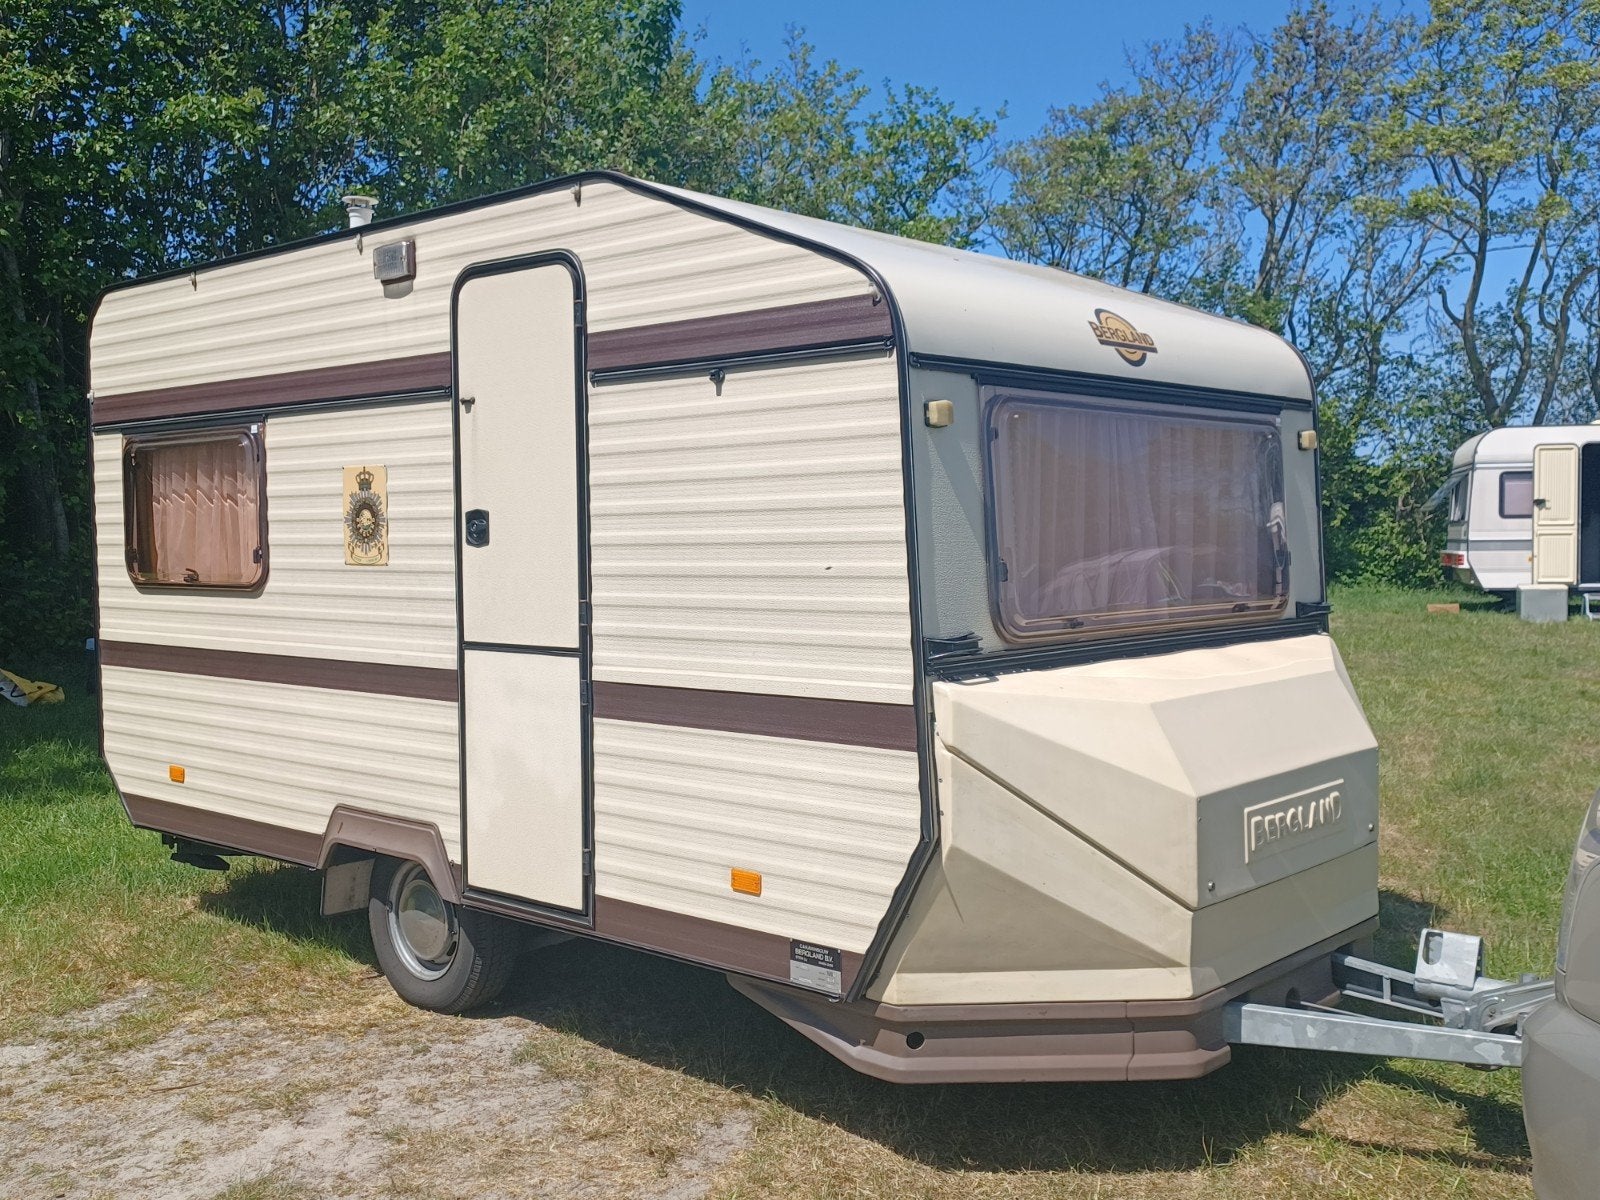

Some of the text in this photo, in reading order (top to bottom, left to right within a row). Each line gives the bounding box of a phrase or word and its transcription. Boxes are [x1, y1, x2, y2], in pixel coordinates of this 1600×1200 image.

[1088, 320, 1154, 346] BERGLAND
[1250, 791, 1342, 851] BERGLAND
[795, 948, 824, 960] BERGLAND
